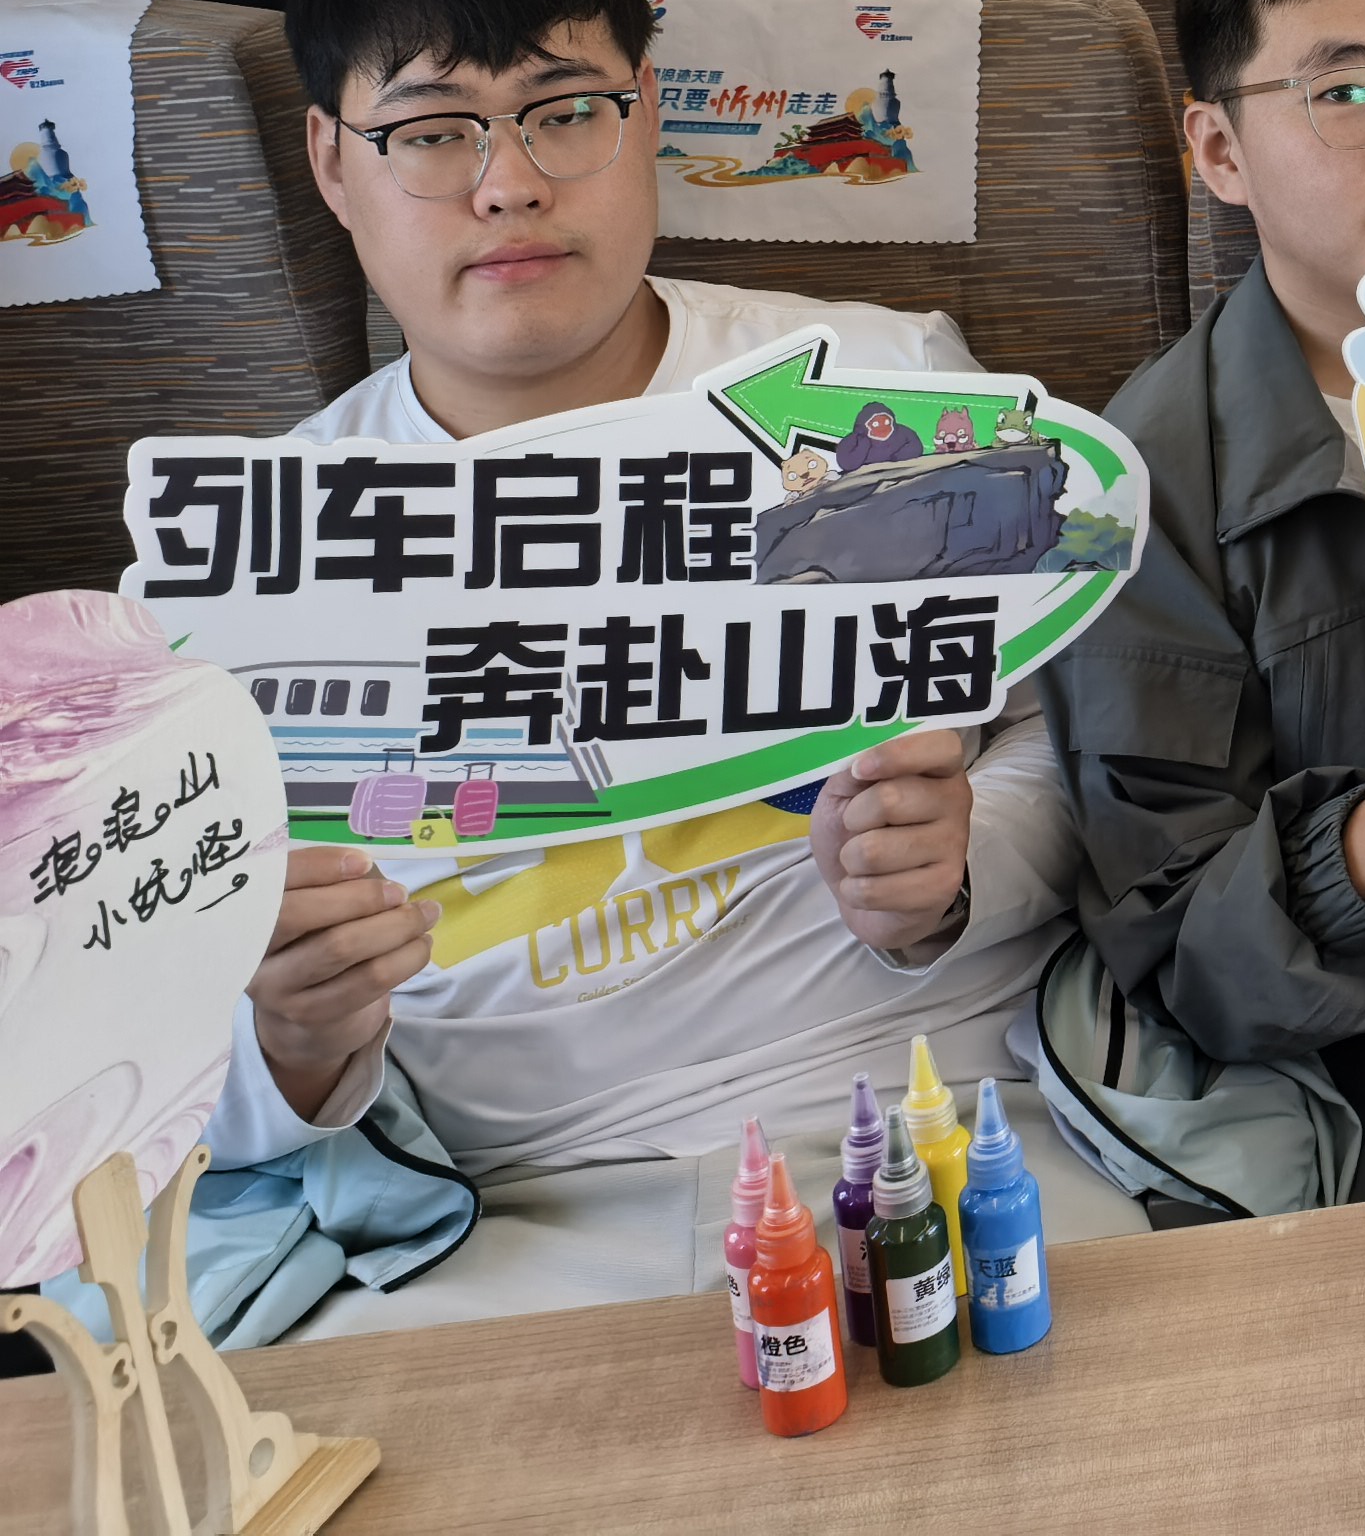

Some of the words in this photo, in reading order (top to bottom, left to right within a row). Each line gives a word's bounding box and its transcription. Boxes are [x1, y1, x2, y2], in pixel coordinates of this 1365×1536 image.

[659, 84, 838, 122] 只要忻州走走
[143, 450, 756, 599] 列车启程
[419, 595, 1000, 754] 奔赴山海
[30, 751, 220, 904] 浪浪山
[83, 818, 251, 950] 小妖怪
[528, 864, 742, 989] CURRY
[760, 1334, 808, 1358] 橙色
